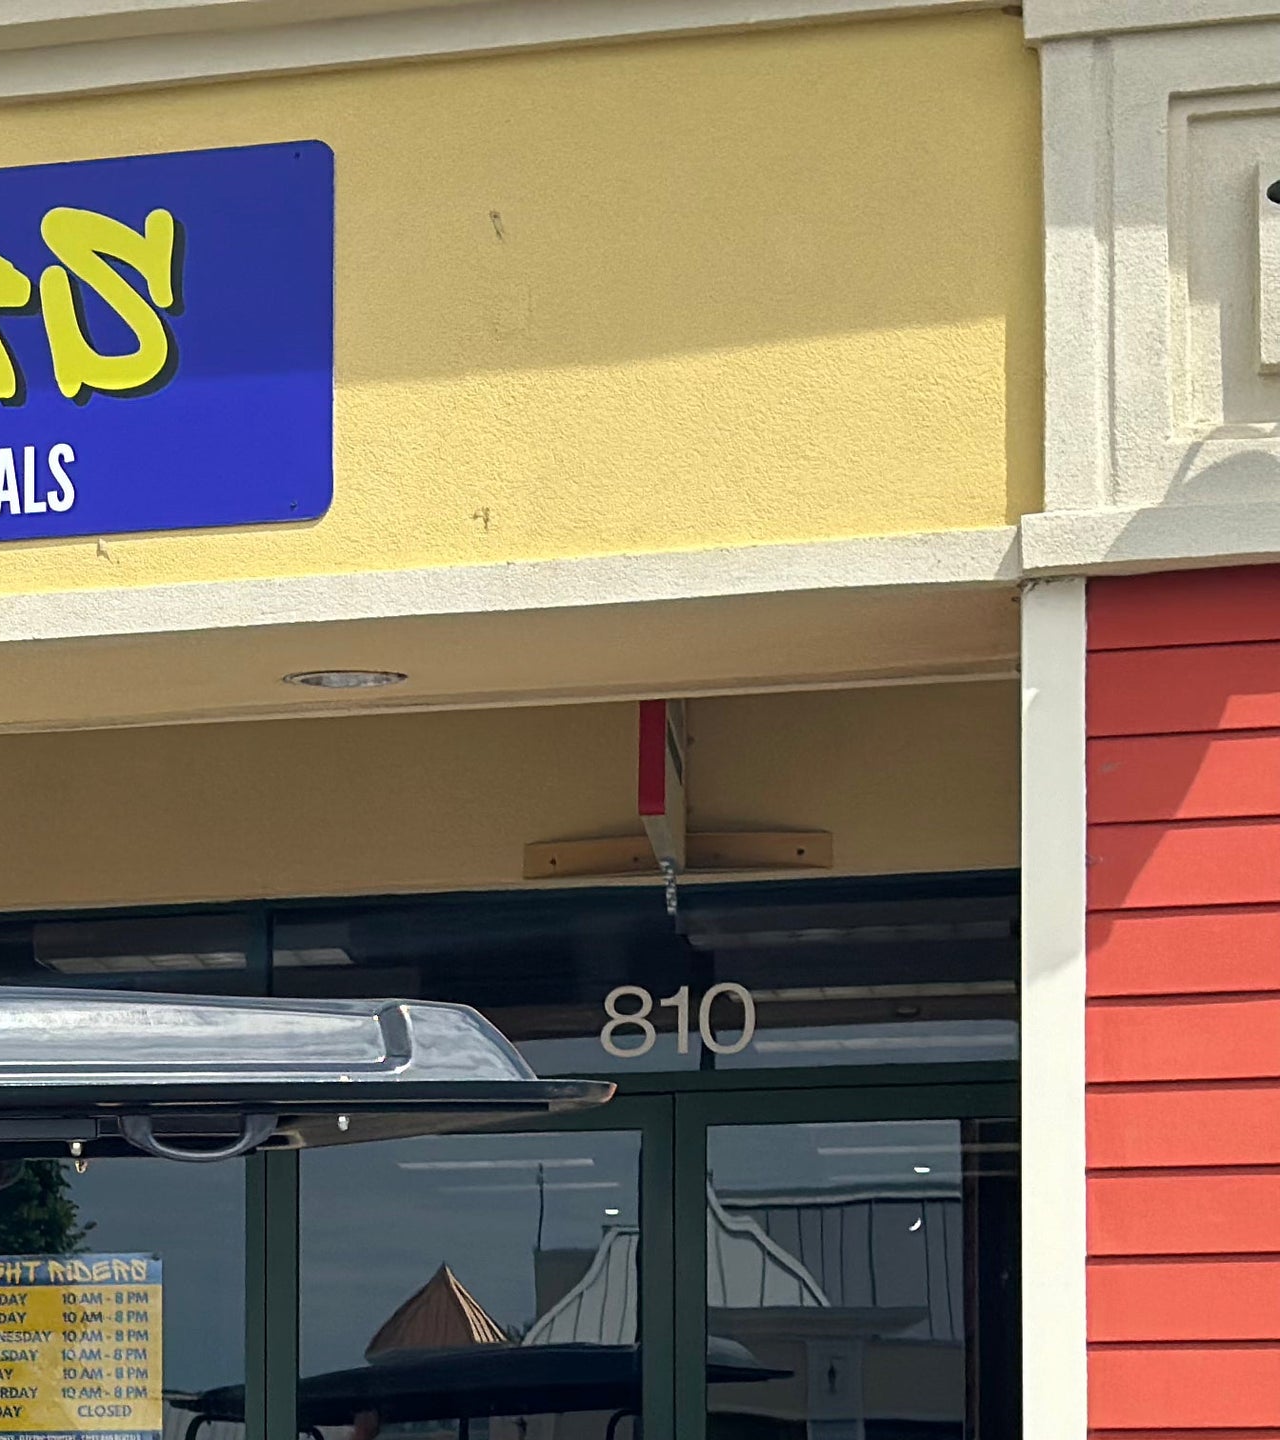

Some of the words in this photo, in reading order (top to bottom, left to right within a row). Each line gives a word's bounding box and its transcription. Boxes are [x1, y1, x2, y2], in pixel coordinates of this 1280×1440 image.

[600, 981, 756, 1059] 810
[62, 1292, 76, 1306] 10
[79, 1292, 103, 1305] AM
[115, 1291, 124, 1305] 8
[127, 1290, 149, 1304] PM
[62, 1311, 76, 1324] 10
[80, 1311, 103, 1323] AM
[114, 1310, 124, 1323] 8
[127, 1310, 149, 1323] PM
[62, 1330, 76, 1343] 10
[80, 1330, 103, 1343] AM
[114, 1330, 124, 1343] 8
[127, 1329, 149, 1342] PM
[61, 1349, 76, 1362] 10
[79, 1348, 102, 1361] AM
[113, 1348, 123, 1361] 8
[126, 1348, 148, 1361] PM
[62, 1368, 76, 1381] 10
[80, 1368, 103, 1380] AM
[114, 1367, 124, 1380] 8
[127, 1367, 149, 1380] PM
[61, 1386, 76, 1399] 10
[79, 1386, 102, 1399] AM
[113, 1385, 123, 1398] 8
[126, 1385, 148, 1398] PM
[78, 1405, 132, 1418] CLOSED
